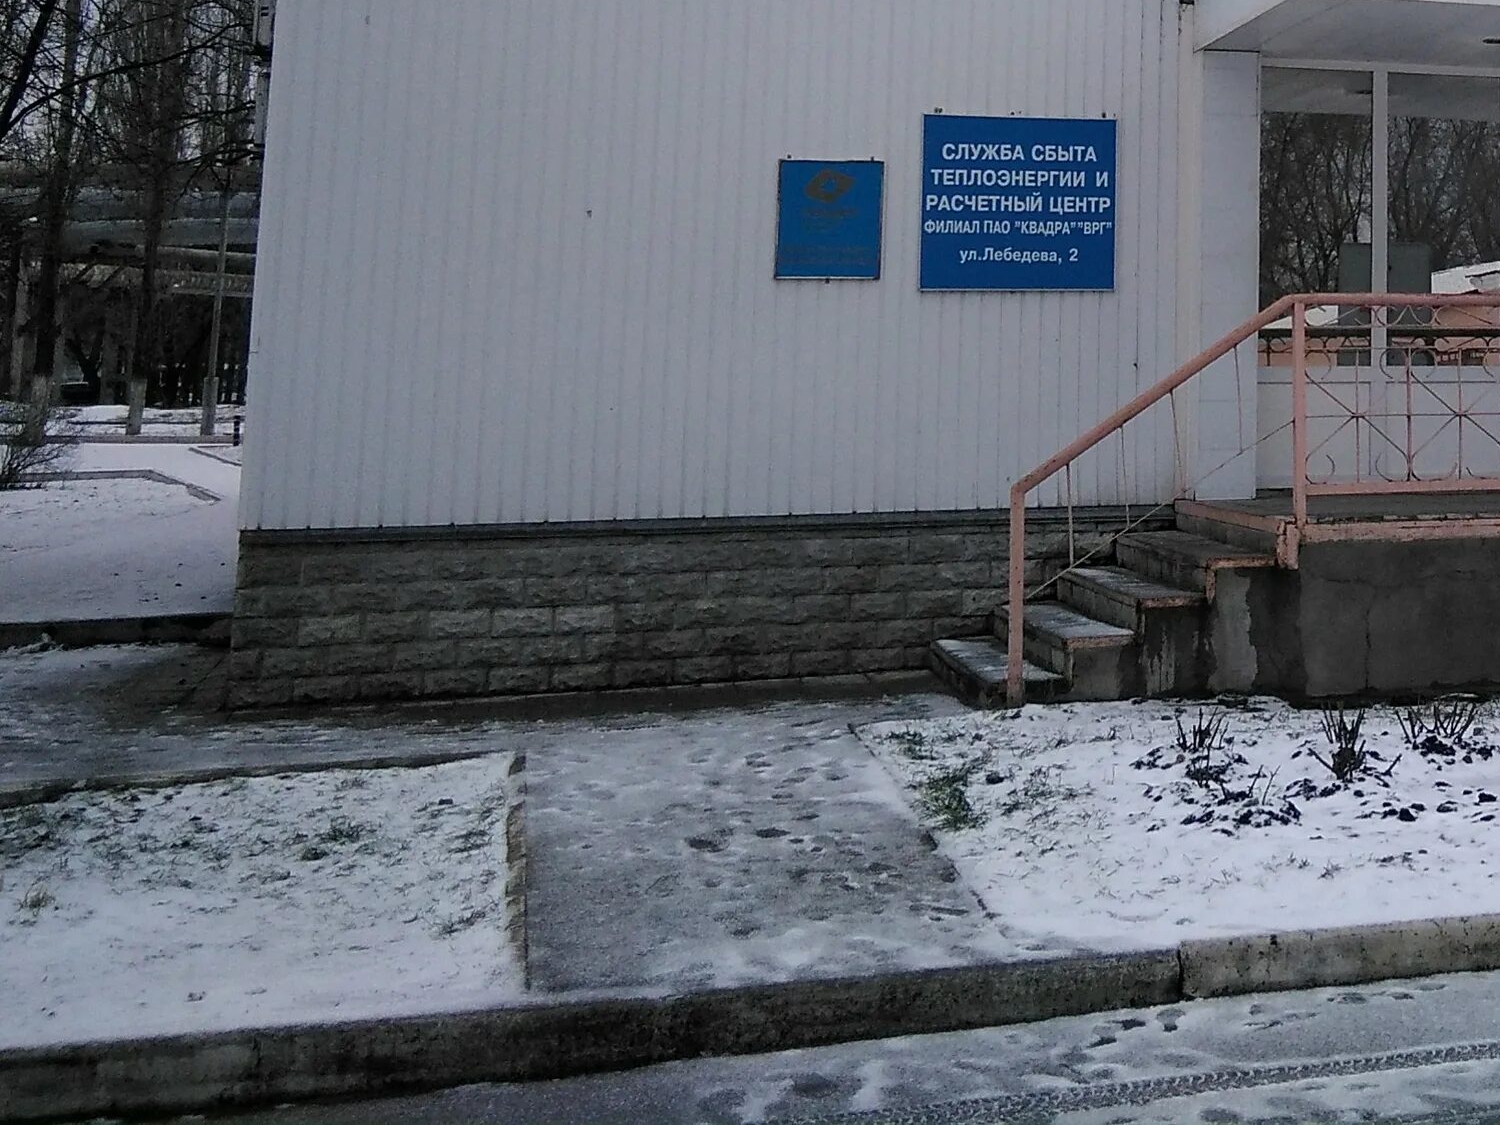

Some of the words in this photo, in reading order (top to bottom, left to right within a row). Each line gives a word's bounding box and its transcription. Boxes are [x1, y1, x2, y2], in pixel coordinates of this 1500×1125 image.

[942, 143, 1025, 161] СЛУЖБА
[1031, 144, 1097, 162] СБЫТА
[930, 168, 1086, 187] ТЕПЛОЭНЕРГИИ
[1095, 170, 1109, 188] И
[925, 191, 1043, 212] РАСЧЕТНЫЙ
[1049, 196, 1111, 215] ЦЕНТР
[924, 219, 980, 234] ФИЛИАЛ
[983, 220, 1011, 234] ПАО
[1069, 248, 1079, 262] 2
